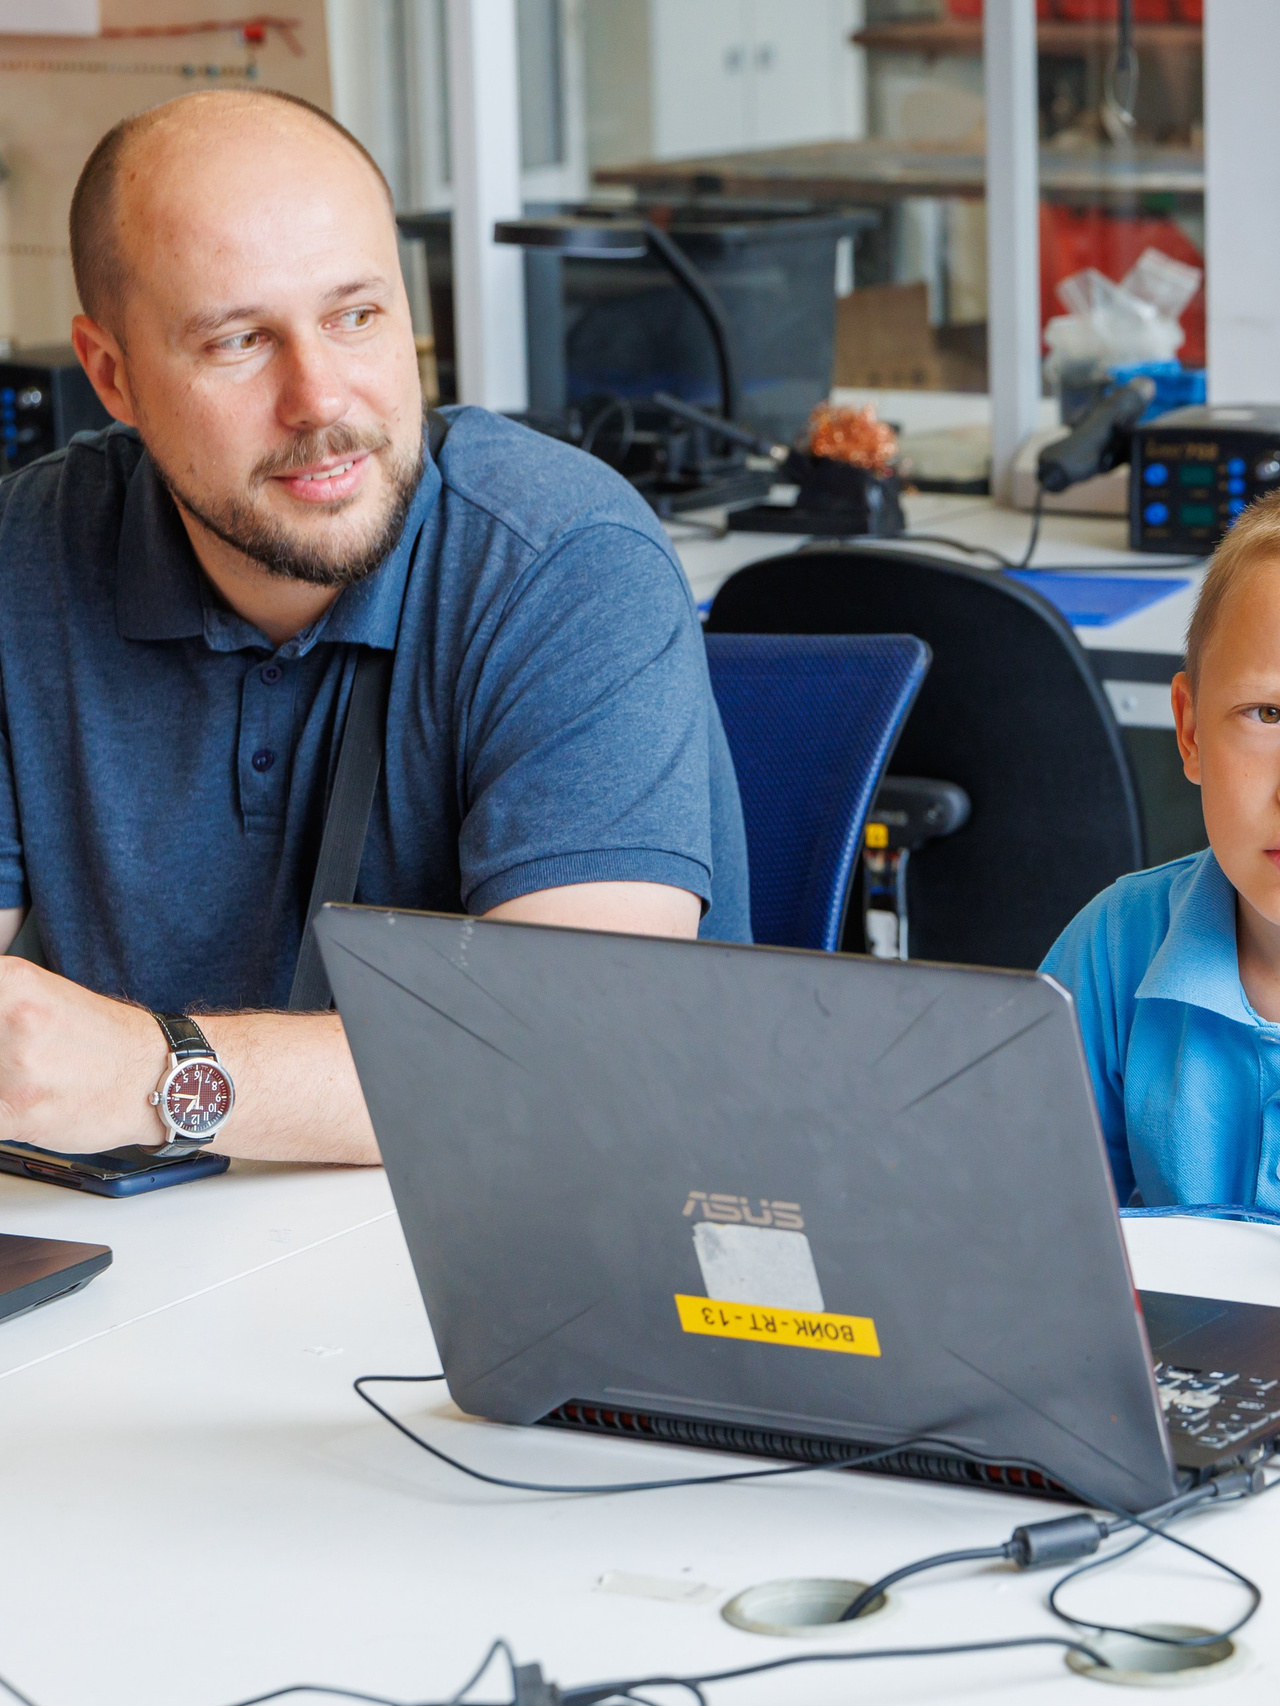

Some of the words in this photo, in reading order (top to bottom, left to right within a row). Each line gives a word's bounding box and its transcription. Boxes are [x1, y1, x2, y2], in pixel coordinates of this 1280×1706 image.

[183, 1073, 189, 1083] 5
[194, 1070, 200, 1079] 6
[205, 1074, 210, 1083] 7
[175, 1083, 181, 1093] 4
[211, 1081, 217, 1091] 8
[215, 1093, 221, 1102] 9
[174, 1103, 180, 1112] 2
[208, 1103, 217, 1112] 10
[182, 1112, 186, 1121] 1
[191, 1114, 200, 1125] 12
[203, 1112, 209, 1121] 11
[682, 1190, 804, 1230] ASUS
